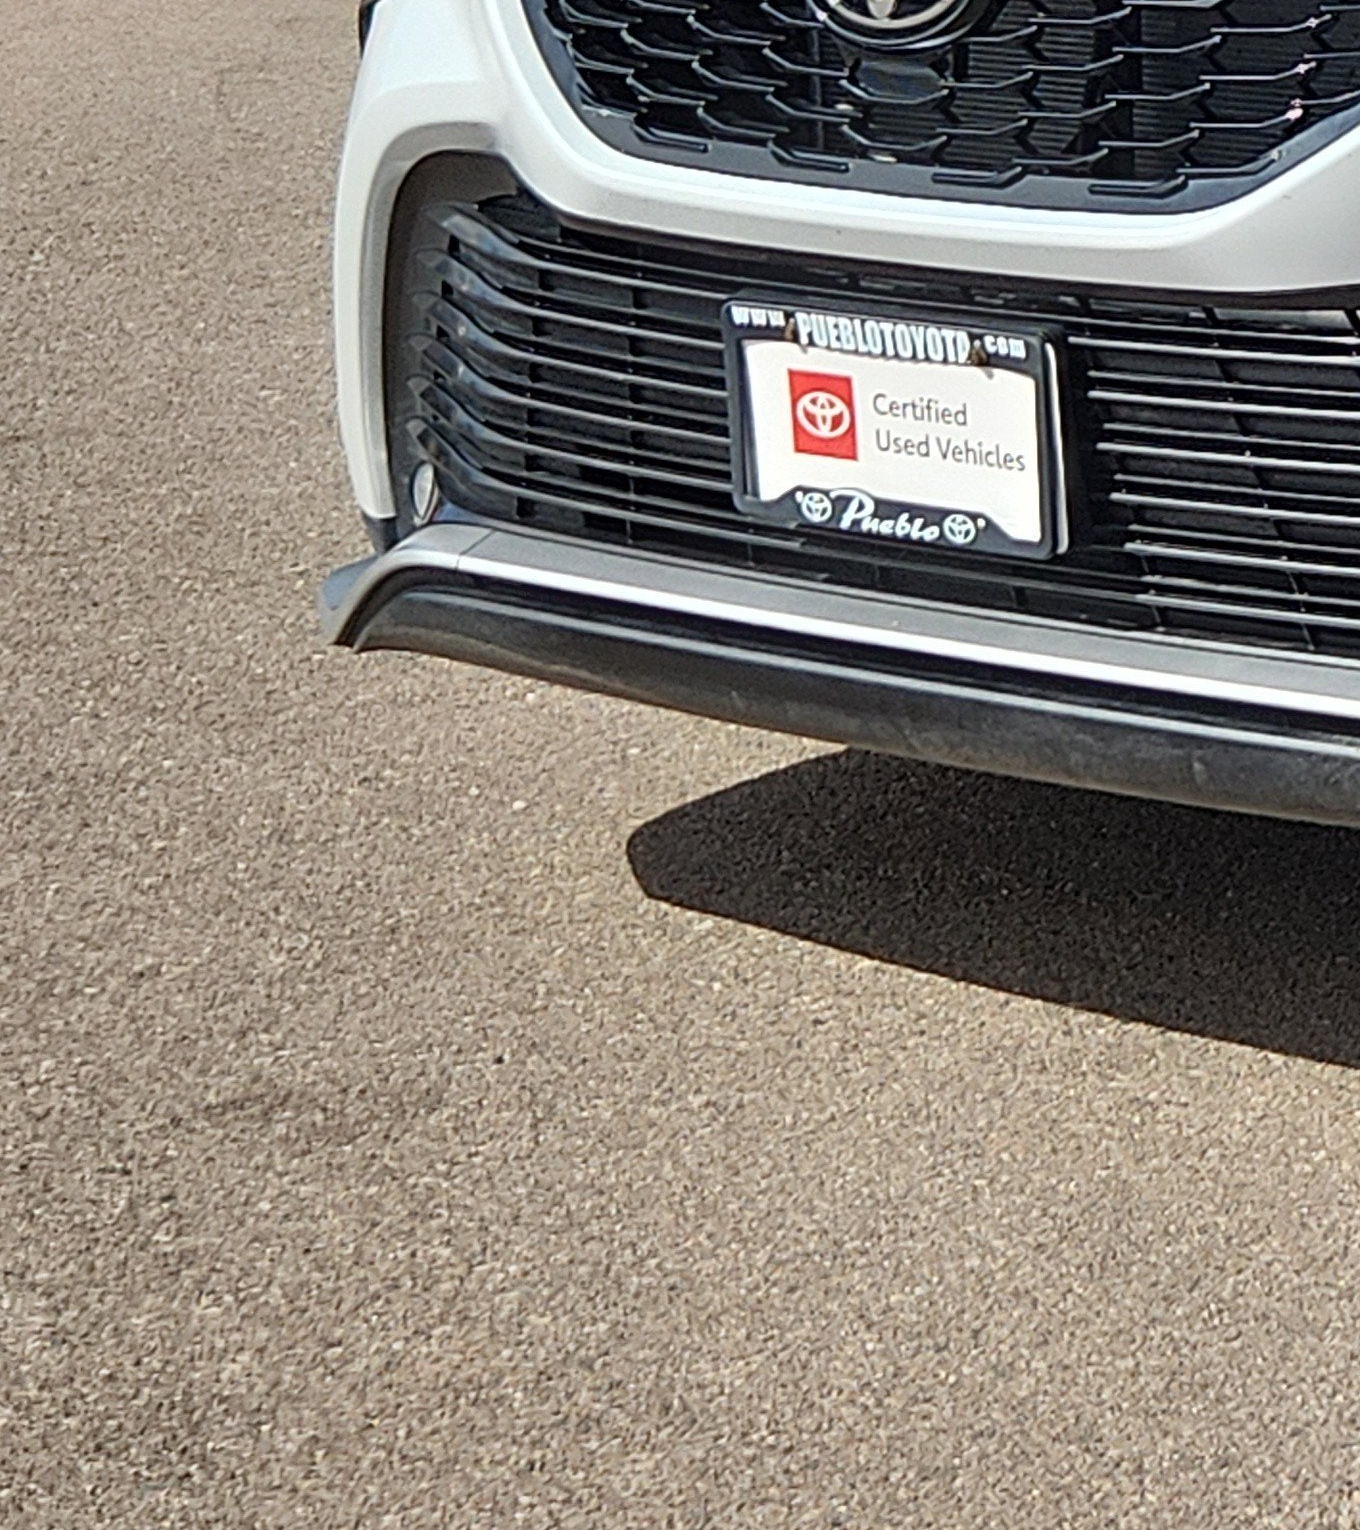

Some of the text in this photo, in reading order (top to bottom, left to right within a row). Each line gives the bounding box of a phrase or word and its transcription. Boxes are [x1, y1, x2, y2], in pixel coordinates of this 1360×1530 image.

[873, 392, 968, 427] Certified
[875, 428, 1026, 472] Used Vehicles
[829, 488, 941, 542] Pueblo
